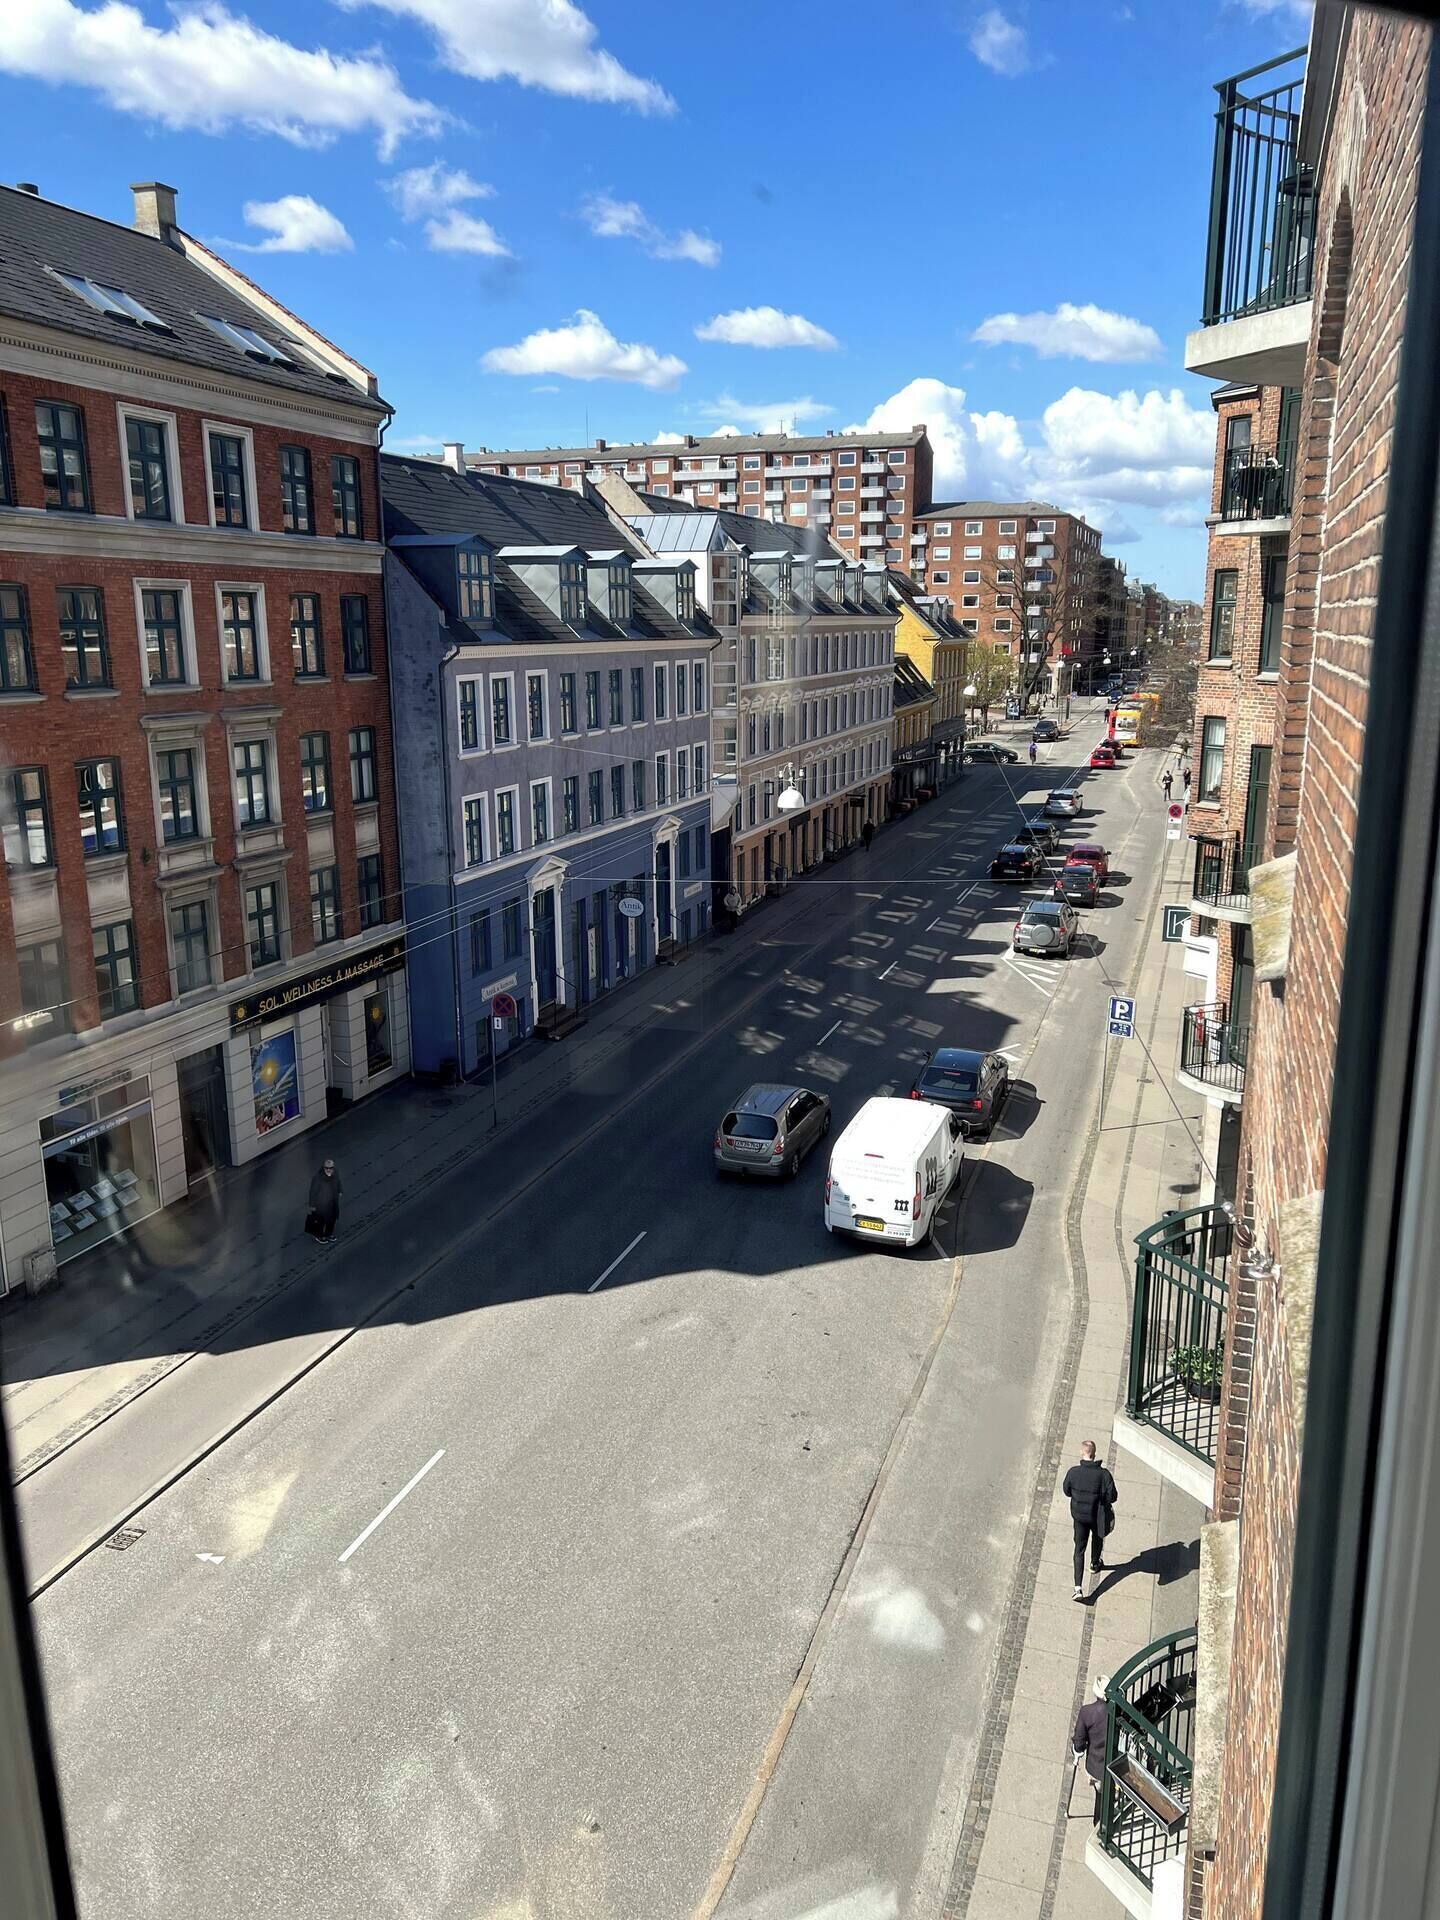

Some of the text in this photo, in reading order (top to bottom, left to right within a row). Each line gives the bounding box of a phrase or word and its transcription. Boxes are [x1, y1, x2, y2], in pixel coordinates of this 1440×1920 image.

[258, 997, 280, 1013] SOL
[282, 975, 333, 1003] WELLNESS
[344, 954, 384, 983] MASSAGE
[1115, 1001, 1130, 1018] P
